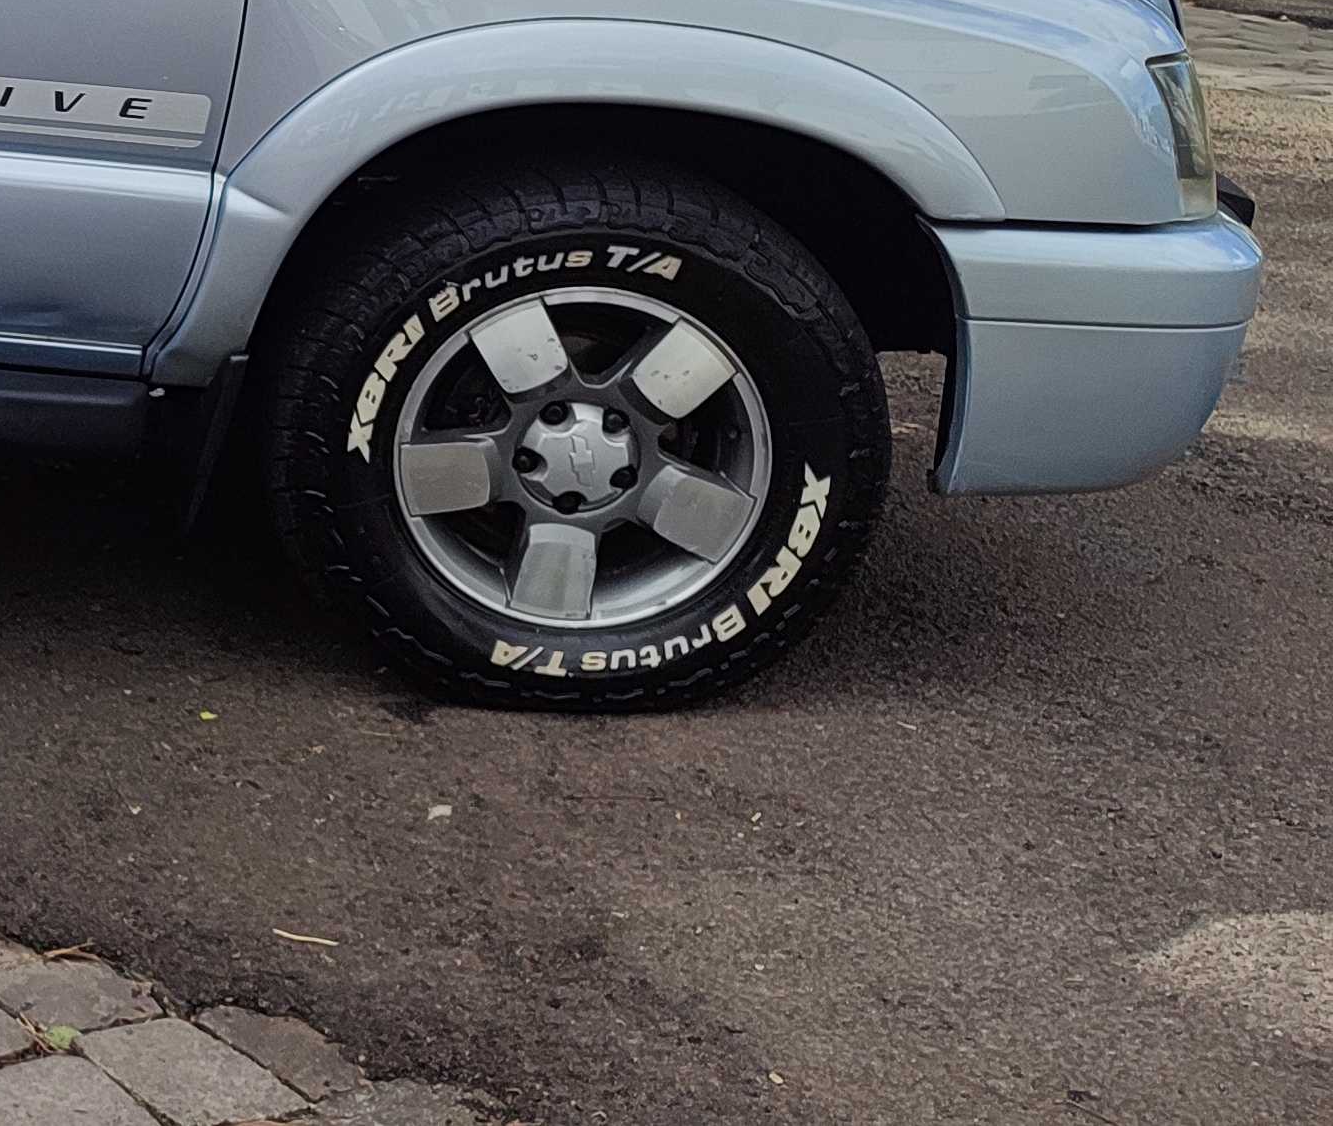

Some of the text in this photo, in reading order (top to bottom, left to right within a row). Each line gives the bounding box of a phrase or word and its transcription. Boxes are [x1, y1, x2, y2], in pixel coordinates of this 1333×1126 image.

[346, 244, 683, 464] XBRI Brutus T/A
[490, 462, 831, 678] XBRI Brutus T/A
